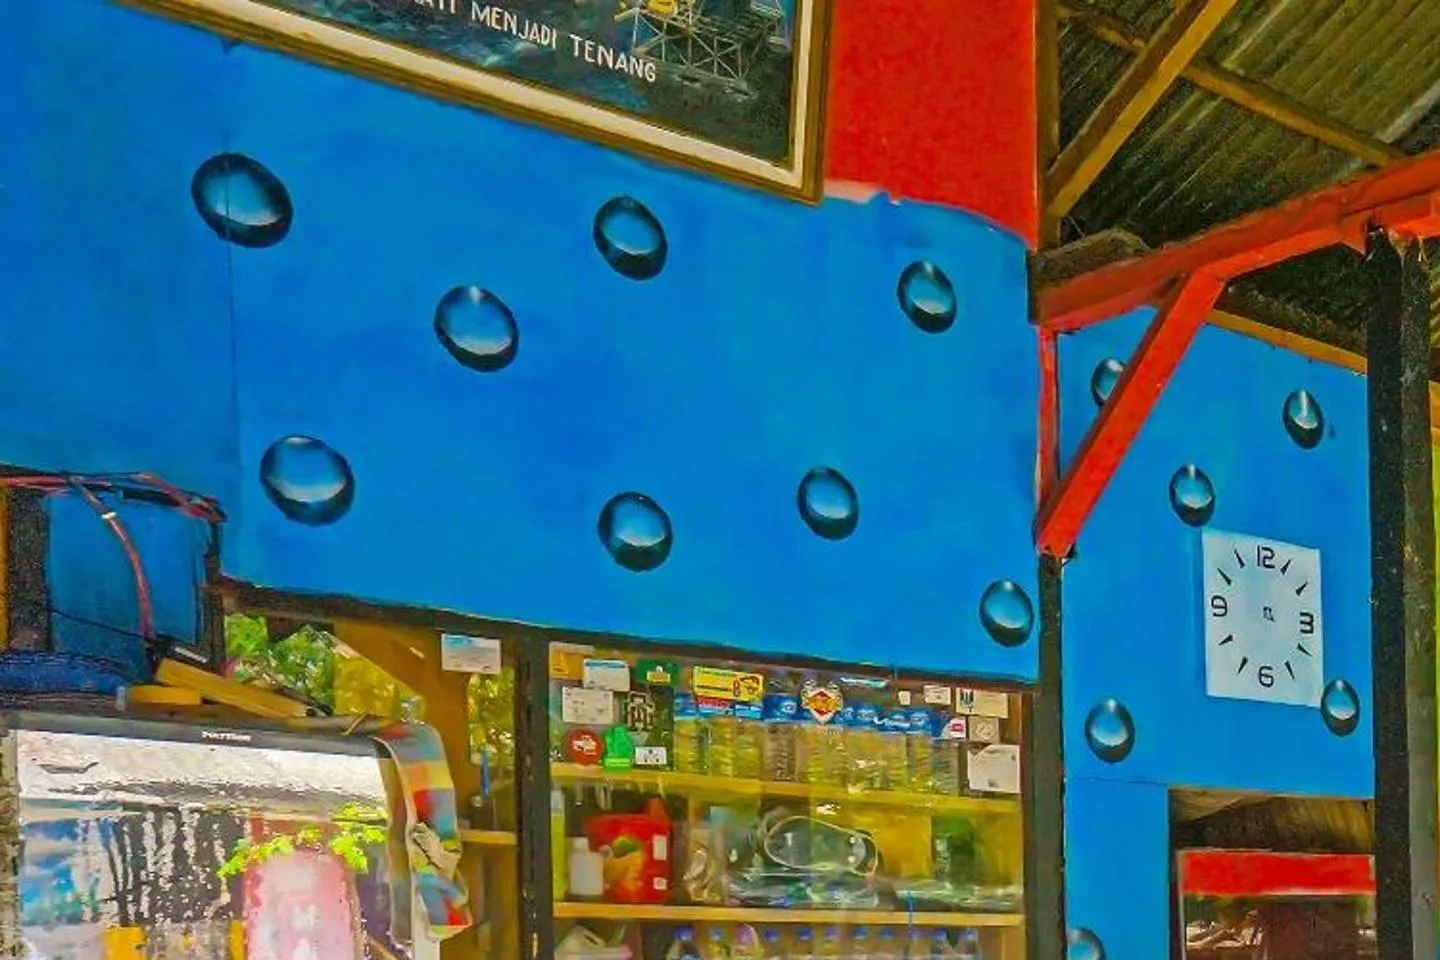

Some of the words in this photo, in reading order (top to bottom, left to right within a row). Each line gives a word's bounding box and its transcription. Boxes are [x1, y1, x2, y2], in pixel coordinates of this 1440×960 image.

[471, 2, 556, 49] MENJADI
[569, 34, 656, 83] TENANG
[1257, 545, 1276, 569] 12
[1211, 595, 1228, 617] 9
[1299, 612, 1314, 634] 3
[1258, 666, 1275, 688] 6
